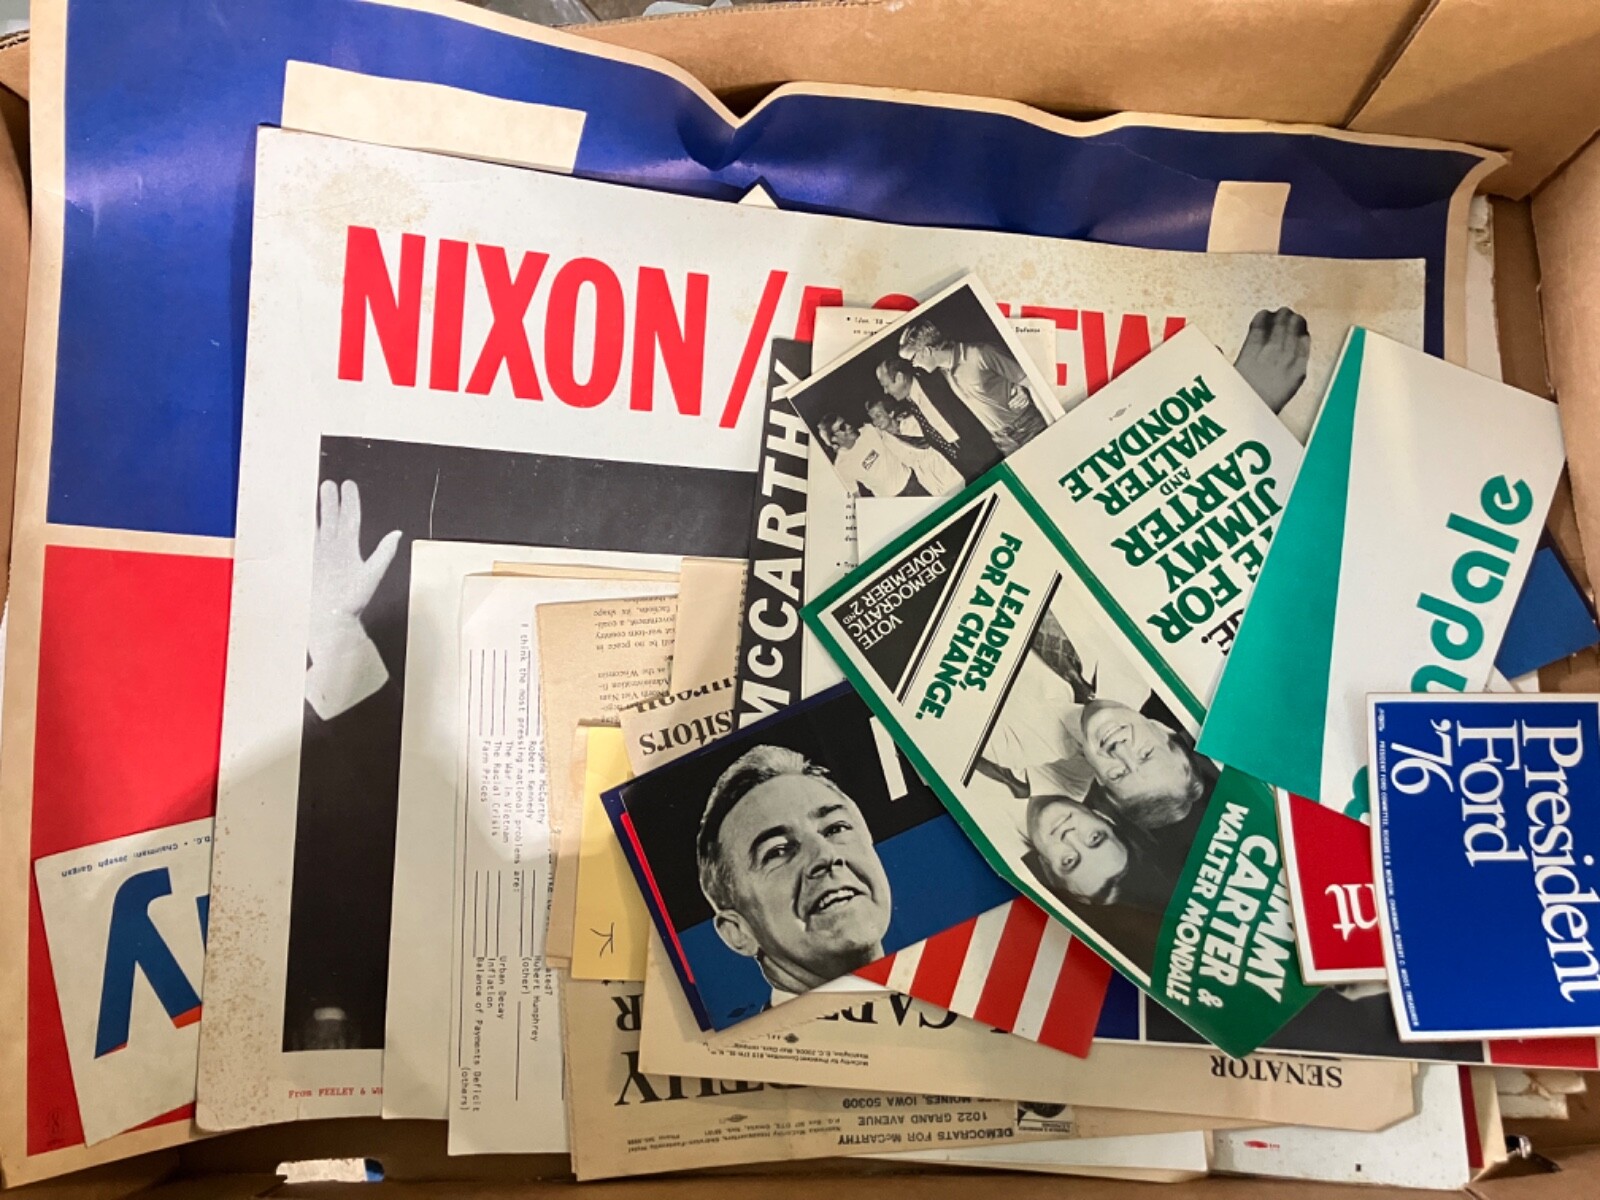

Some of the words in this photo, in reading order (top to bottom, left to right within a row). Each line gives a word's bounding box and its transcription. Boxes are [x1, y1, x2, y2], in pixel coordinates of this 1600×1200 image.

[1058, 375, 1216, 503] MONDALE
[1093, 414, 1228, 516] WALTER
[1160, 467, 1191, 496] AND
[1110, 440, 1272, 567] CARTER
[1155, 477, 1283, 594] JIMMY
[860, 540, 947, 603] NOVEMBER
[980, 531, 1023, 585] FOR
[847, 560, 947, 638] DEMOCRATIC
[969, 585, 996, 608] A
[1147, 564, 1242, 644] FOR
[519, 634, 529, 662] think
[857, 614, 904, 650] VOTE
[519, 668, 528, 684] the
[915, 612, 985, 720] CHANGE.
[518, 689, 526, 712] most
[493, 741, 503, 759] The
[504, 741, 514, 759] The
[515, 717, 527, 763] pressing
[639, 710, 734, 756] sitors
[481, 740, 492, 765] Farm
[527, 741, 538, 773] Robert
[1379, 740, 1387, 773] PRESIDENT
[1391, 719, 1454, 795] '76
[480, 769, 490, 803] Prices
[492, 763, 502, 797] Racial
[504, 764, 514, 780] War
[1380, 775, 1388, 790] FORD
[515, 768, 526, 813] national
[524, 780, 537, 820] Kennedy
[536, 779, 547, 826] McCarthy
[1456, 719, 1530, 868] Ford
[490, 802, 501, 838] Crisis
[502, 803, 513, 844] Vietnam
[513, 819, 525, 866] problems
[1191, 801, 1250, 900] WALTER
[97, 856, 128, 868] Joseph
[1521, 718, 1600, 1003] President
[1198, 834, 1278, 987] CARTER
[1165, 897, 1209, 1006] MONDALE
[1243, 868, 1296, 1004] MMY
[474, 956, 486, 997] Balance
[486, 957, 497, 1009] Inflation
[497, 956, 508, 986] Urban
[521, 957, 532, 995] (other)
[531, 955, 543, 990] Hubert
[474, 1001, 484, 1013] of
[496, 991, 506, 1020] Decay
[1197, 987, 1224, 1009] &
[530, 996, 542, 1042] Humphrey
[472, 1019, 483, 1065] Payments
[839, 1058, 869, 1067] McCarthy
[1211, 1055, 1343, 1089] SENATOR
[288, 1089, 312, 1099] From
[318, 1086, 355, 1097] FEELEY
[459, 1066, 471, 1111] (others)
[472, 1071, 483, 1112] Deficit
[842, 1097, 881, 1109] 50309
[885, 1096, 917, 1107] IOWA
[920, 1094, 972, 1106] MOINES,
[857, 1115, 905, 1127] AVENUE
[909, 1113, 952, 1124] GRAND
[956, 1111, 988, 1122] 1022
[838, 1133, 902, 1146] McCARTHY
[906, 1131, 932, 1142] FOR
[936, 1127, 1014, 1142] DEMOCRATS
